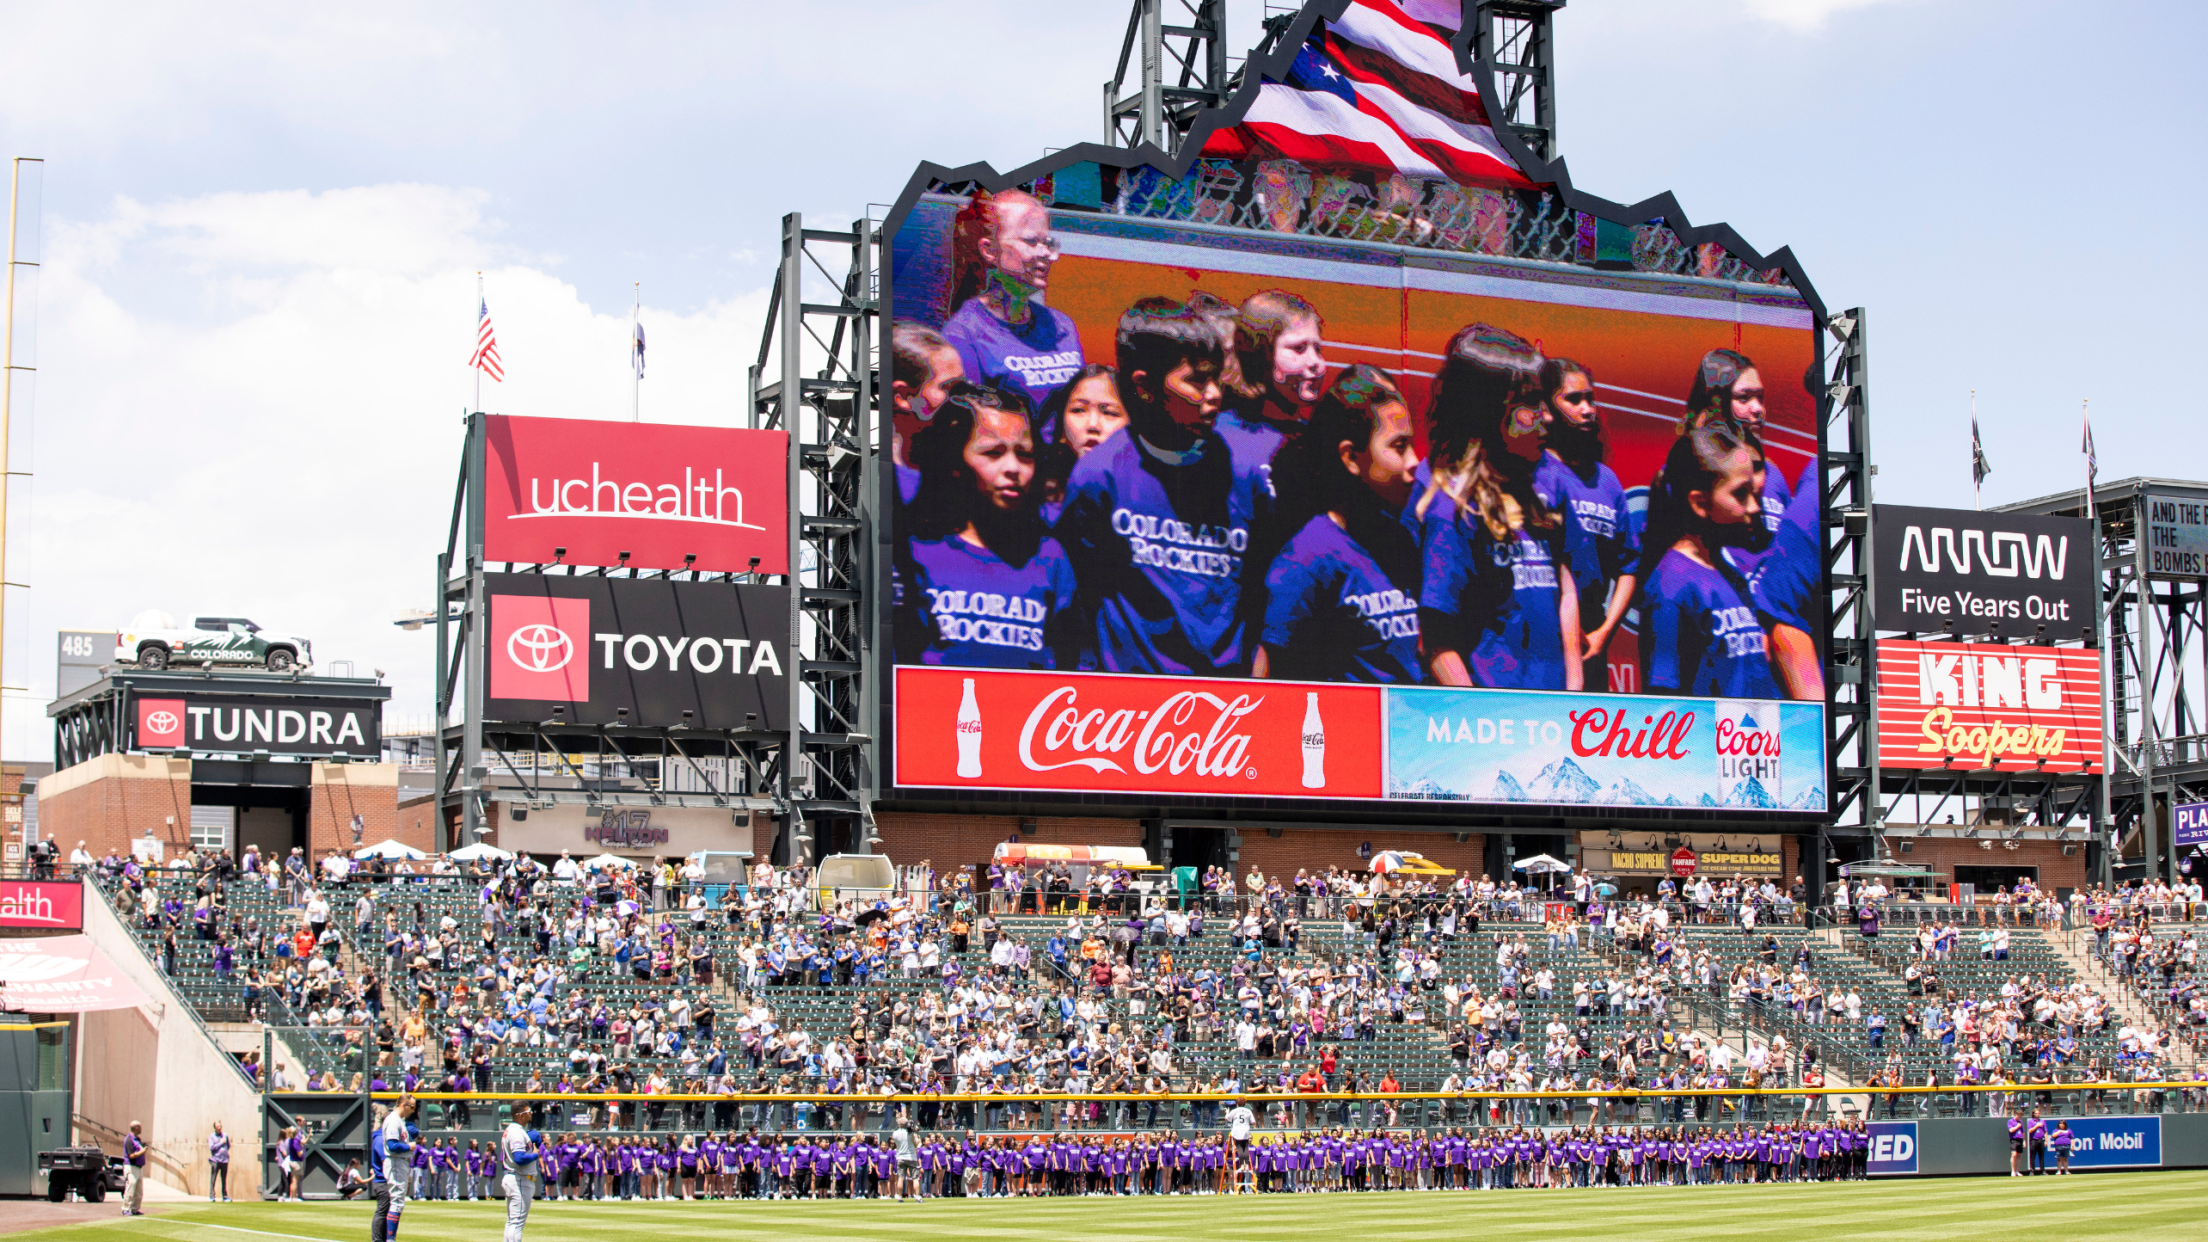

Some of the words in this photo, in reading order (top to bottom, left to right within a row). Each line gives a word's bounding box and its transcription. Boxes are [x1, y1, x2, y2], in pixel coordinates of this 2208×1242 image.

[531, 462, 743, 524] uchealth
[2152, 501, 2176, 523] AND
[2179, 503, 2201, 526] THE
[2152, 526, 2177, 548] THE
[2154, 551, 2201, 574] BOMBS
[1901, 588, 1951, 615] Five
[1955, 591, 2021, 619] Years
[2025, 595, 2070, 622] Out
[936, 614, 1044, 651] ROCKIES
[62, 635, 93, 657] 485
[190, 649, 254, 660] COLORADO
[595, 633, 783, 676] TOYOTA
[1918, 654, 2062, 710] KING
[187, 706, 365, 746] TUNDRA
[1018, 685, 1266, 777] Coca-Cola
[1427, 717, 1516, 745] MADE
[1523, 719, 1562, 746] TO
[1569, 707, 1696, 760] Chill
[1715, 717, 1780, 758] Coors
[1917, 706, 2066, 768] Soopers
[1722, 757, 1778, 779] LIGHT
[5, 806, 22, 815] SELF
[585, 826, 669, 843] HELTON
[1612, 852, 1634, 869] NACHO
[1635, 852, 1666, 869] SUPREME
[1672, 858, 1696, 866] FANFARE
[1701, 853, 1749, 864] SUPER
[1750, 854, 1780, 865] DOG
[2100, 1132, 2144, 1150] Mobil
